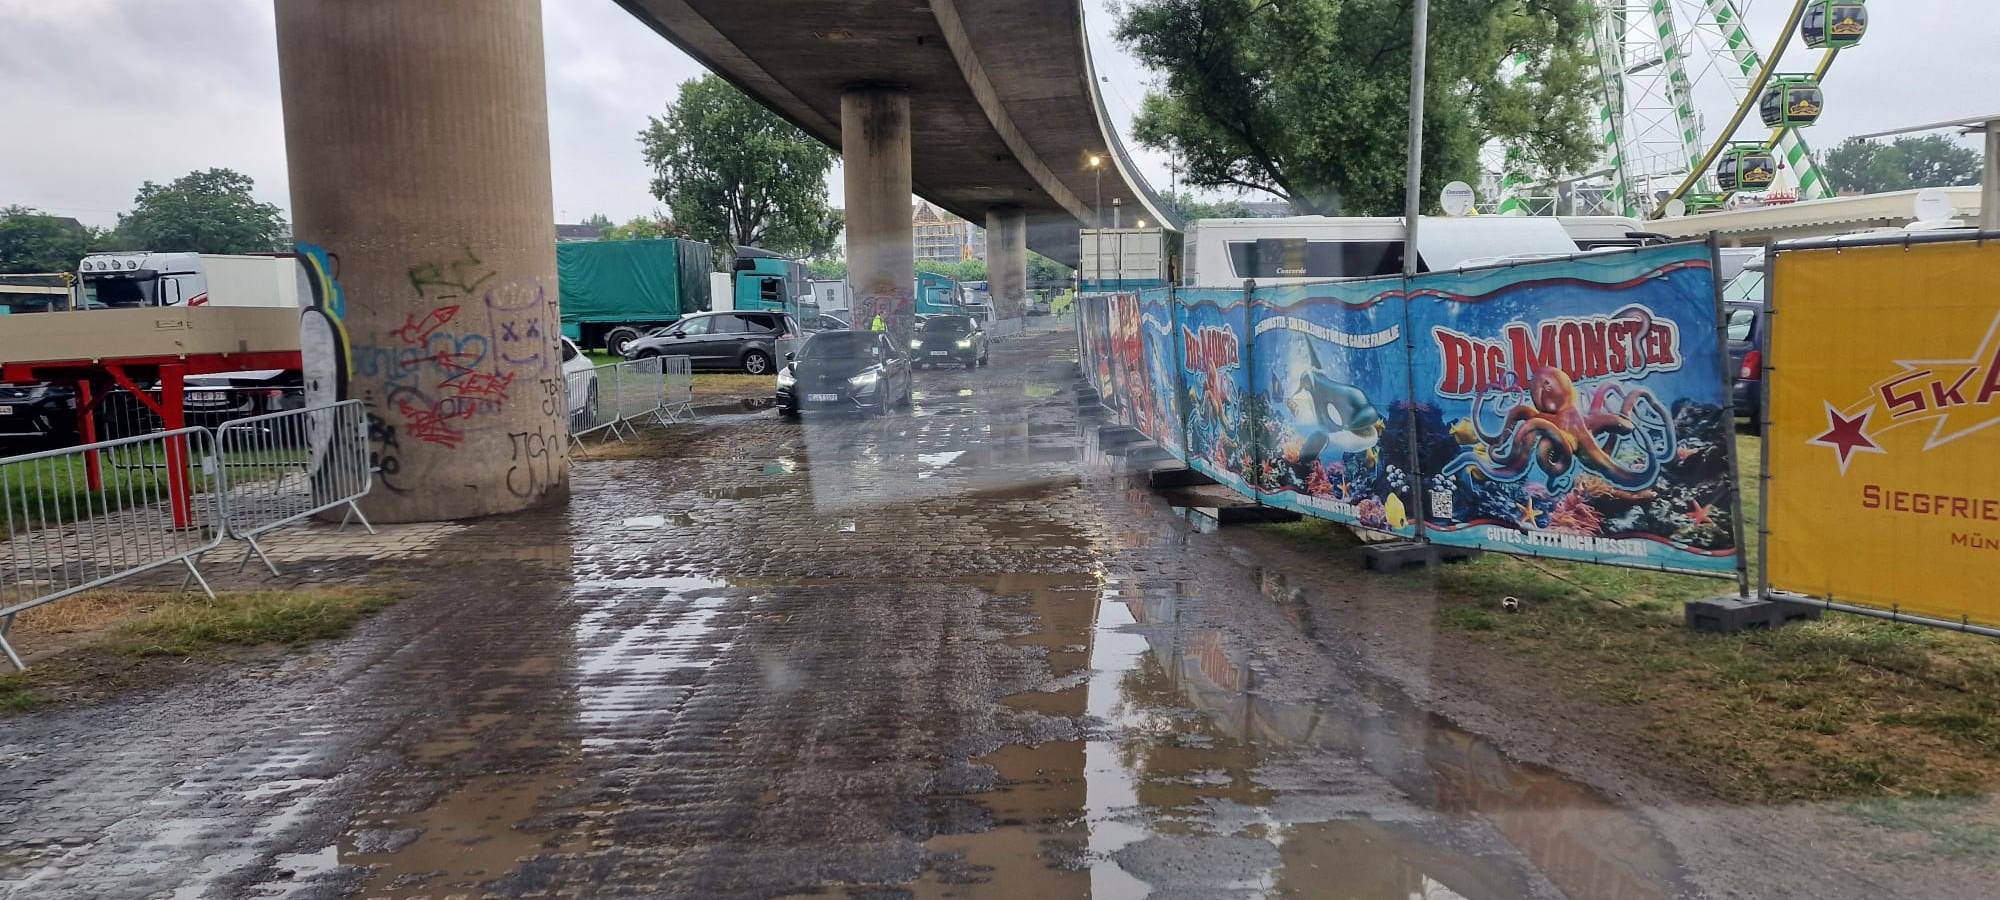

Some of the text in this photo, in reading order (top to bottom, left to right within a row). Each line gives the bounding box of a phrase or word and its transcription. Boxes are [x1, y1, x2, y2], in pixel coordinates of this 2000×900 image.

[1276, 266, 1307, 275] Concorde
[1435, 319, 1676, 394] BIG MONSTER
[1863, 484, 1999, 521] SIEGFRIE
[1527, 530, 1560, 549] JETZT
[1561, 533, 1593, 552] NOCH
[1595, 536, 1648, 557] BESSER!
